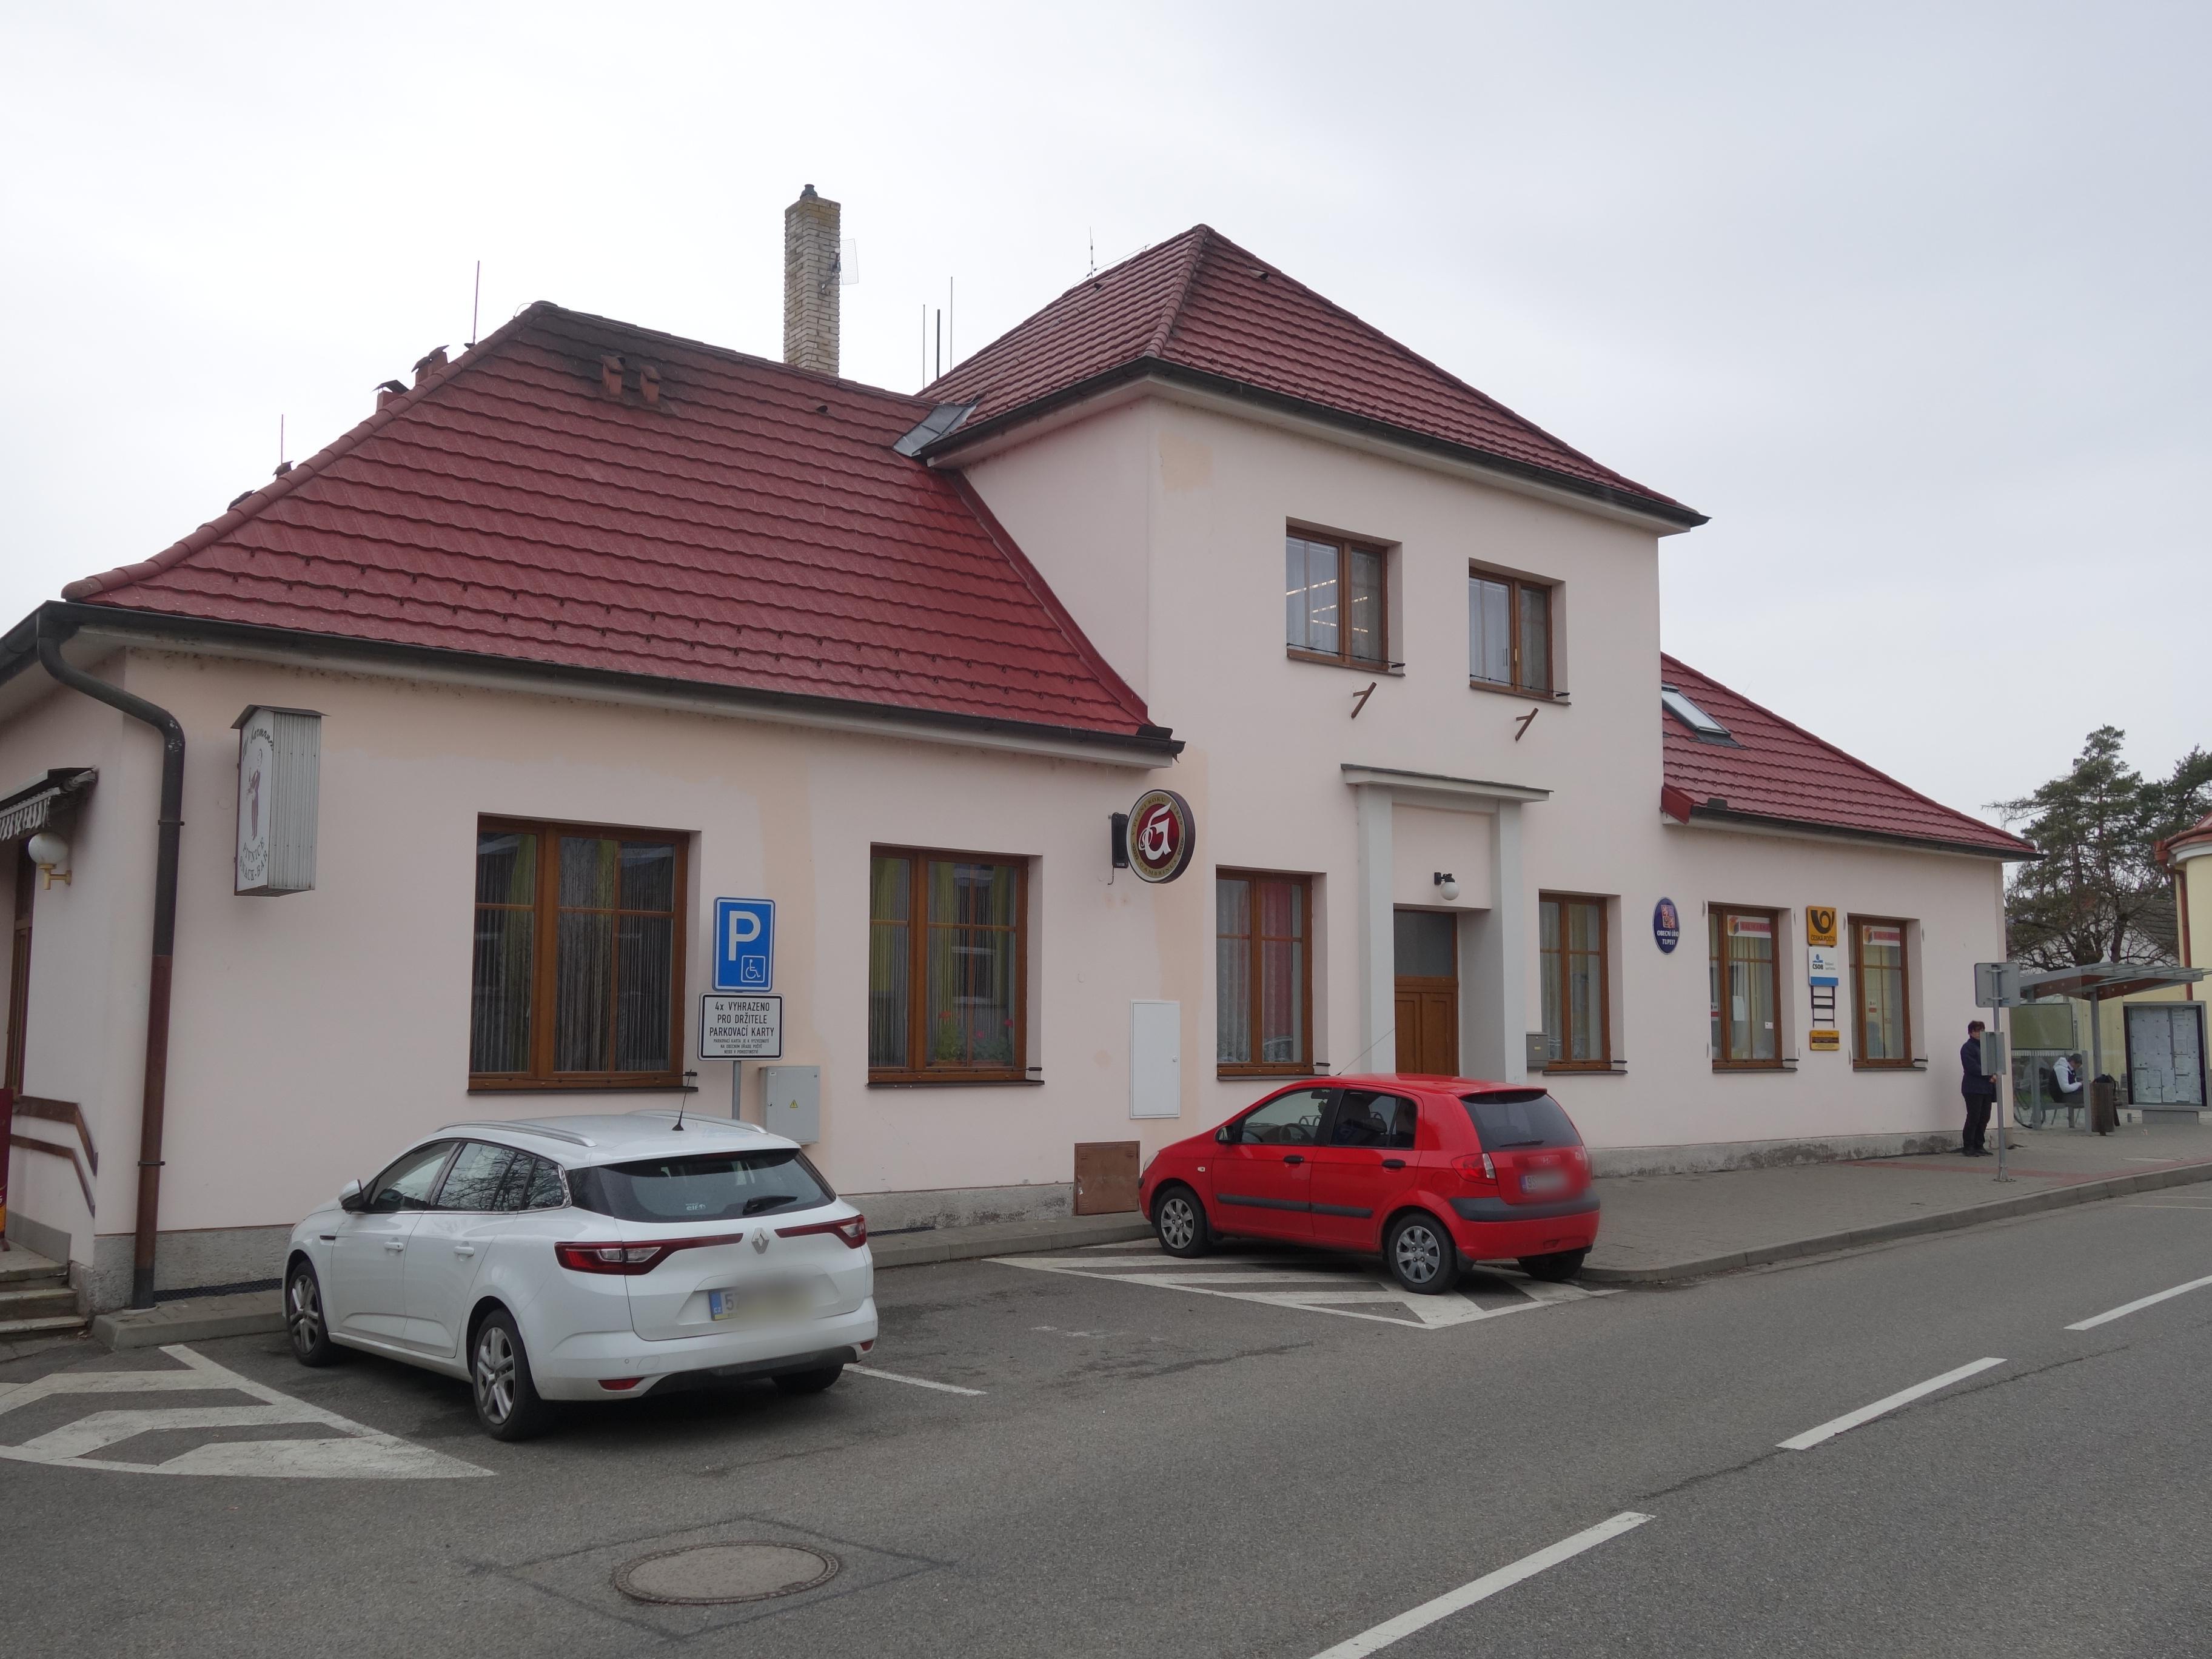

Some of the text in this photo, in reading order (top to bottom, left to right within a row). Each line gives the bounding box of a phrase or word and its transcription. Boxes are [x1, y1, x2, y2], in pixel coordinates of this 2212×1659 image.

[1140, 860, 1177, 876] GAMBRINUS
[728, 910, 761, 961] P
[715, 1001, 770, 1011] 4x VYHRAZENO
[717, 1012, 767, 1024] PRO DRŽITELE
[709, 1025, 774, 1036] PARKOVACÍ KARTY
